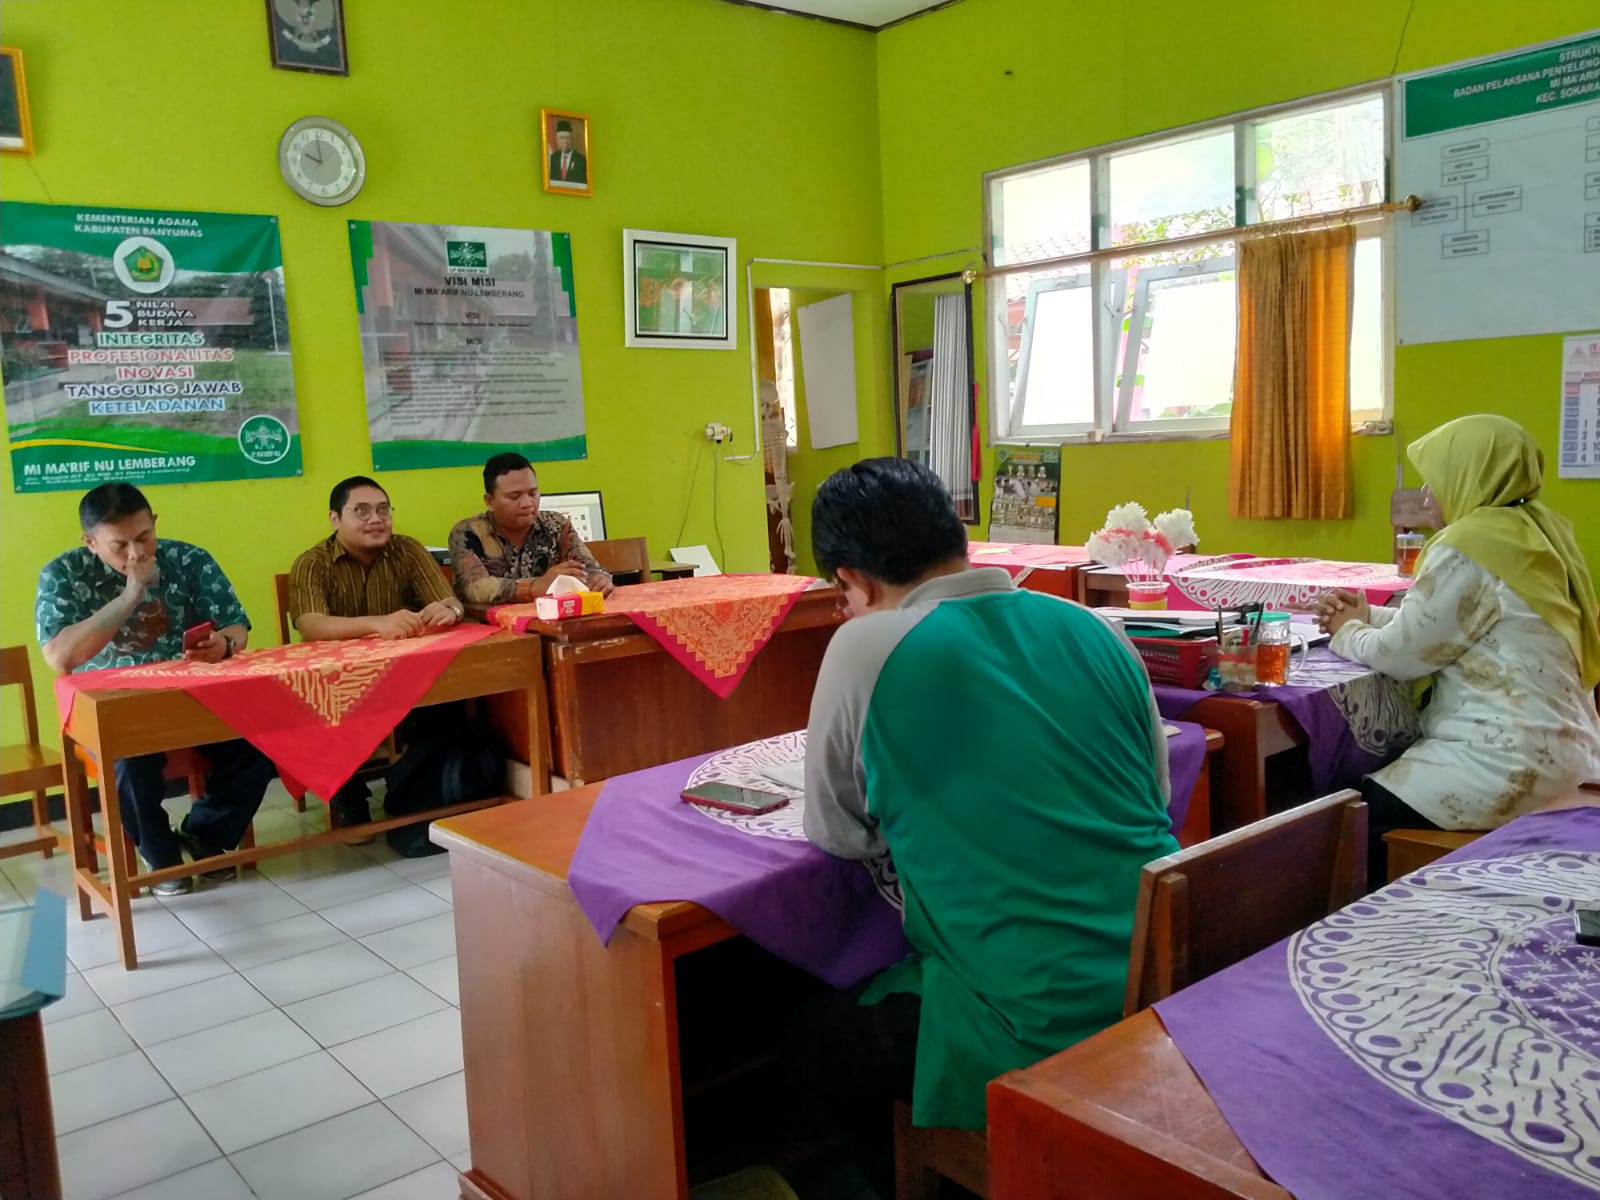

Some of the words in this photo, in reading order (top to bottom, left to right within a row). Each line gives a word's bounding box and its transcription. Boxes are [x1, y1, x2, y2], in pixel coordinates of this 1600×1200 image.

[1454, 84, 1485, 98] BADAN
[1486, 71, 1541, 91] PELAKSANA
[1542, 57, 1600, 78] PENYELENG
[1550, 79, 1560, 89] MI
[1560, 81, 1600, 98] SOKARA
[76, 213, 155, 225] KEMENTERIAN
[157, 217, 199, 227] AGAMA
[74, 224, 140, 235] KABUPATEN
[142, 226, 203, 238] BANYUMAS
[444, 277, 468, 286] VISI
[471, 277, 496, 287] MISI
[414, 287, 424, 295] MI
[136, 301, 175, 309] NILAI
[104, 299, 134, 329] 5
[137, 310, 195, 319] BUDAYA
[137, 319, 184, 327] KERJA
[98, 332, 205, 347] INTEGRITAS
[68, 348, 234, 364] PROFESIONALITAS
[117, 365, 194, 380] INOVASI
[65, 384, 178, 399] TANGGUNG
[181, 381, 243, 396] JAWAB
[90, 397, 225, 415] KETELADANAN
[24, 464, 41, 476] MI
[45, 461, 91, 475] MA'RIF
[94, 459, 115, 471] NU
[118, 455, 196, 470] LEMBERANG
